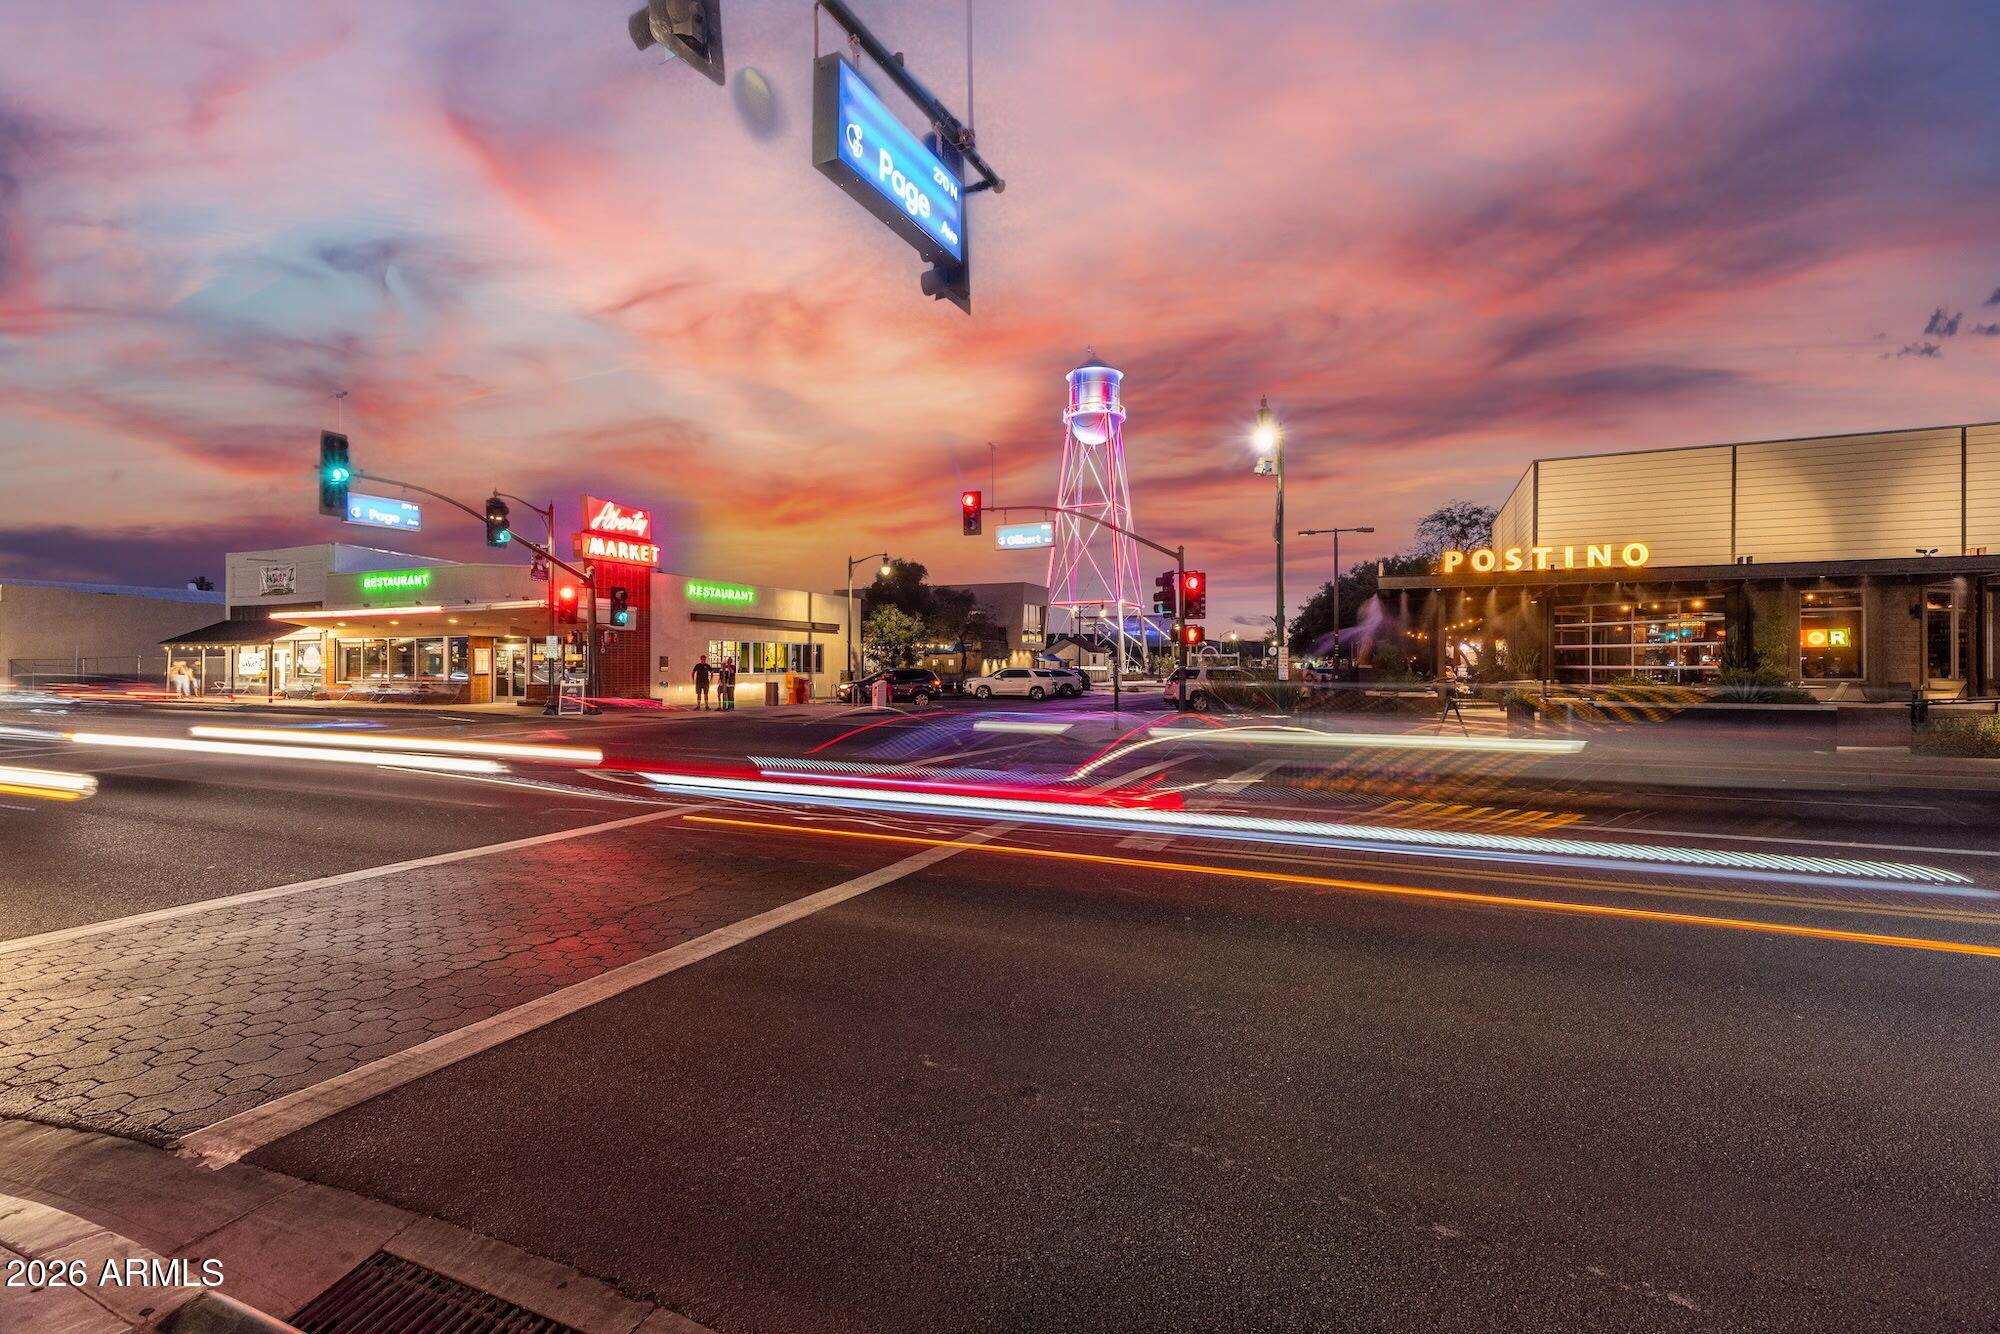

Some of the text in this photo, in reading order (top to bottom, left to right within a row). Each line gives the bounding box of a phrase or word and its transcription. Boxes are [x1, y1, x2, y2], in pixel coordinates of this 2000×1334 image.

[879, 148, 931, 219] Page
[932, 166, 958, 200] 270 N
[940, 221, 958, 245] Ave
[369, 508, 400, 525] Page
[591, 501, 649, 536] Liberty
[588, 537, 660, 562] MARKET
[1006, 534, 1041, 546] Gilbert
[1443, 542, 1650, 573] POSTINO
[363, 574, 429, 588] RESTAURANT
[688, 584, 754, 601] RESTAURANT
